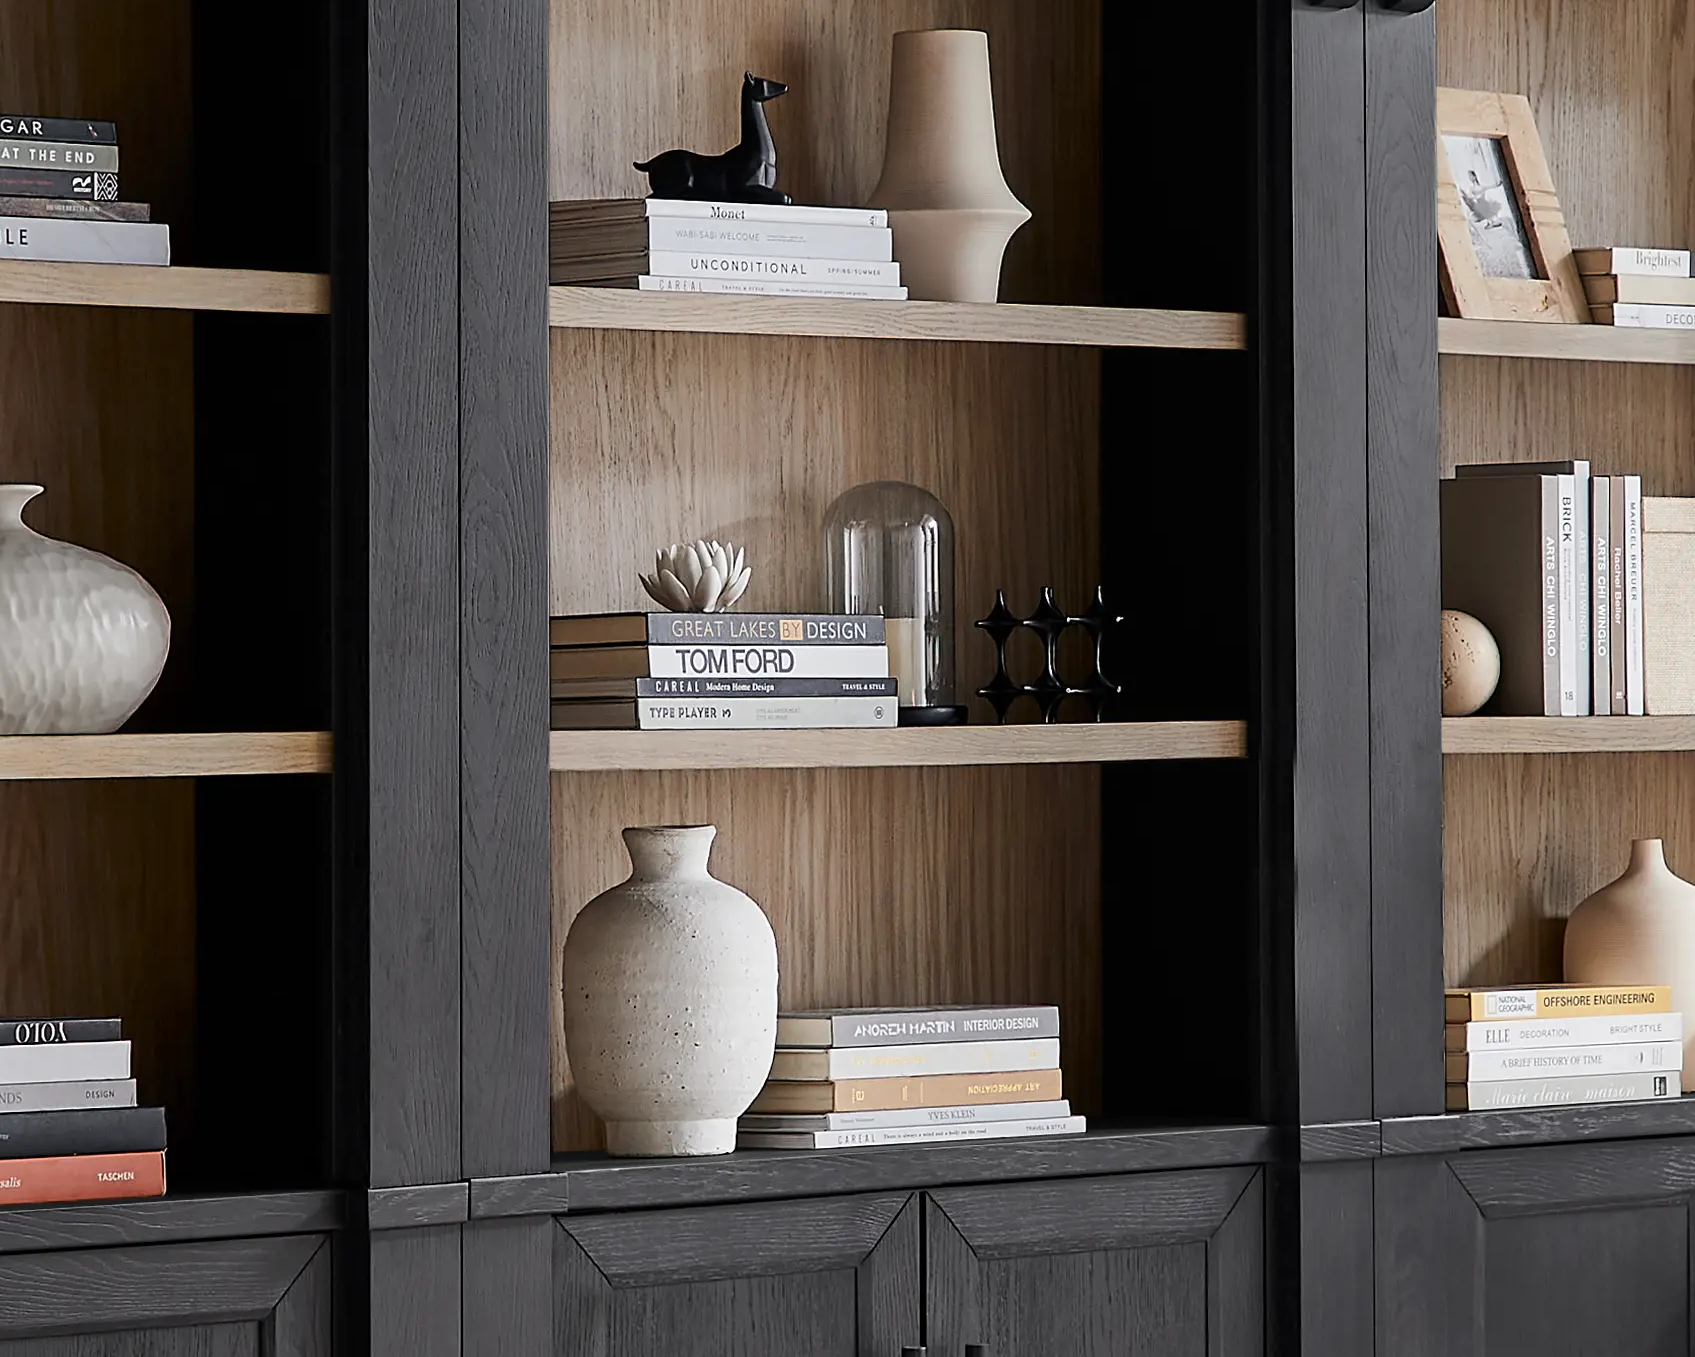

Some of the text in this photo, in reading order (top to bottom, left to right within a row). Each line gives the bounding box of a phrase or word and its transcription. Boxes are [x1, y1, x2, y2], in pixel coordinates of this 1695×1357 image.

[1, 147, 20, 160] AT
[29, 148, 57, 162] THE
[65, 151, 95, 164] END
[710, 206, 746, 220] Monet
[720, 232, 760, 242] WELCOME
[690, 258, 807, 276] UNCONDITIONAL
[1636, 251, 1682, 270] Brightest
[659, 280, 703, 293] CAREAL
[1562, 497, 1573, 542] BRICK
[1614, 547, 1622, 588] Rachel
[1546, 536, 1557, 657] ARTS CHI WINGLO
[1597, 537, 1607, 657] ARTS CHI WINGLO
[671, 620, 866, 639] GREAT LAKES BY DESIGN
[675, 649, 794, 674] TOM FORD
[655, 680, 700, 692] CAREAL
[706, 682, 731, 691] Modern
[732, 682, 751, 692] Home
[752, 683, 775, 694] Design
[1564, 691, 1574, 701] 18
[650, 707, 675, 718] TYPE
[678, 707, 717, 718] PLAYER
[1498, 995, 1526, 1003] NATIONAL
[1543, 992, 1655, 1007] OFFSHORE ENGINEERING
[1498, 1004, 1534, 1013] GEOGRAPHIC
[909, 1020, 955, 1035] MARTIN
[964, 1019, 1004, 1032] INTERIOR
[1005, 1017, 1039, 1030] DESIGN
[1485, 1023, 1662, 1043] ELLE DECORATION BRIGHT STYLE
[1501, 1054, 1603, 1068] A BRIEF HISTORY OF TIME
[85, 1090, 115, 1099] DESIGN
[967, 1083, 1040, 1095] ART APPRECIATION
[1533, 1084, 1573, 1103] claire
[1585, 1084, 1636, 1100] maison
[928, 1109, 976, 1120] YVES KLEIN
[838, 1134, 876, 1144] CAREAL
[97, 1171, 135, 1182] TASCHEN
